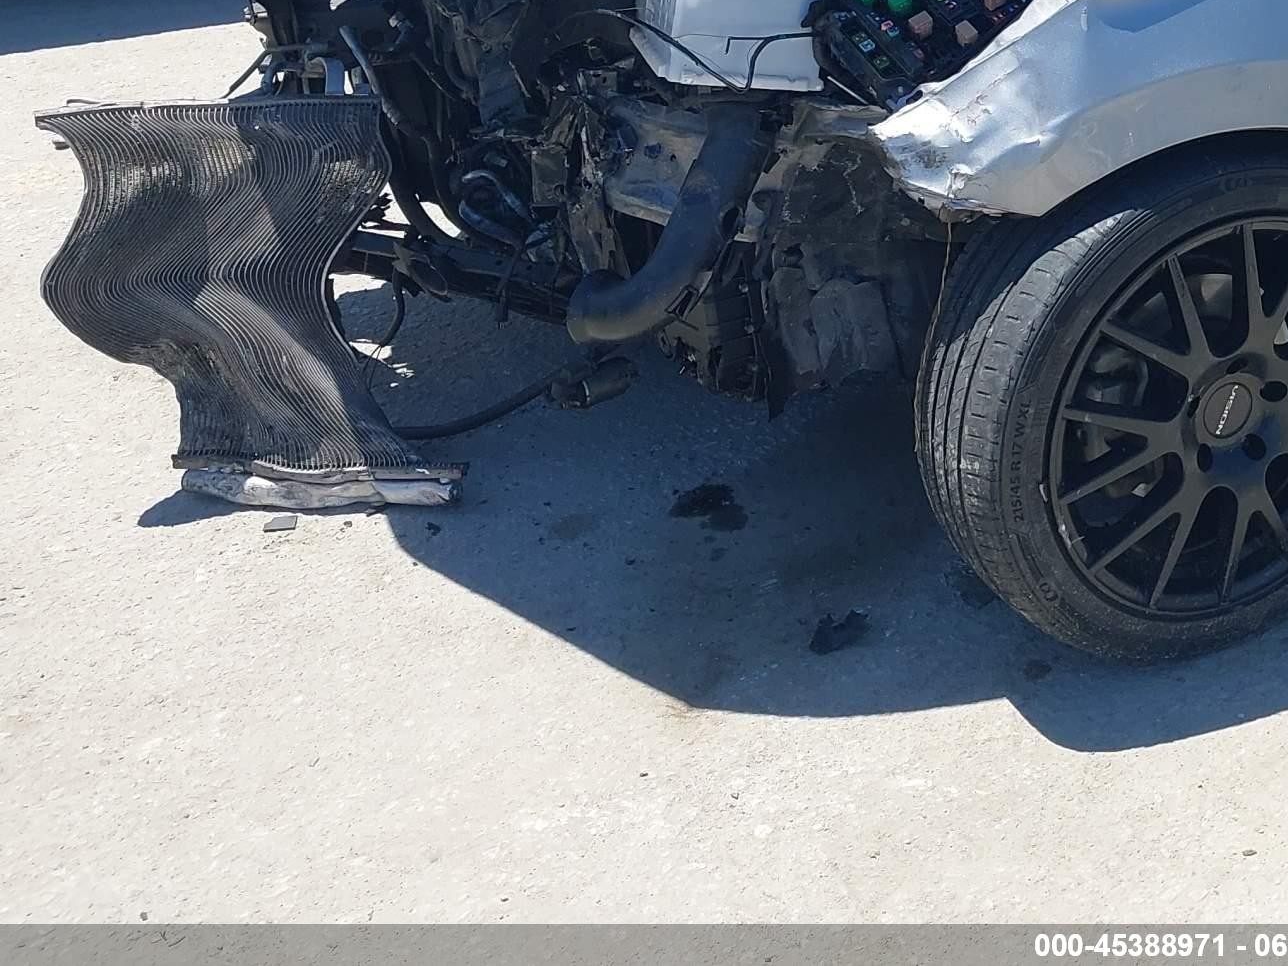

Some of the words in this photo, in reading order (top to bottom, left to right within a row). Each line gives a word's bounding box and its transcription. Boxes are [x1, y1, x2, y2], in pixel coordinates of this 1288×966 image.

[1215, 385, 1239, 435] VISION
[1011, 442, 1024, 457] 17
[1010, 461, 1021, 472] R
[1010, 476, 1025, 523] 215/45
